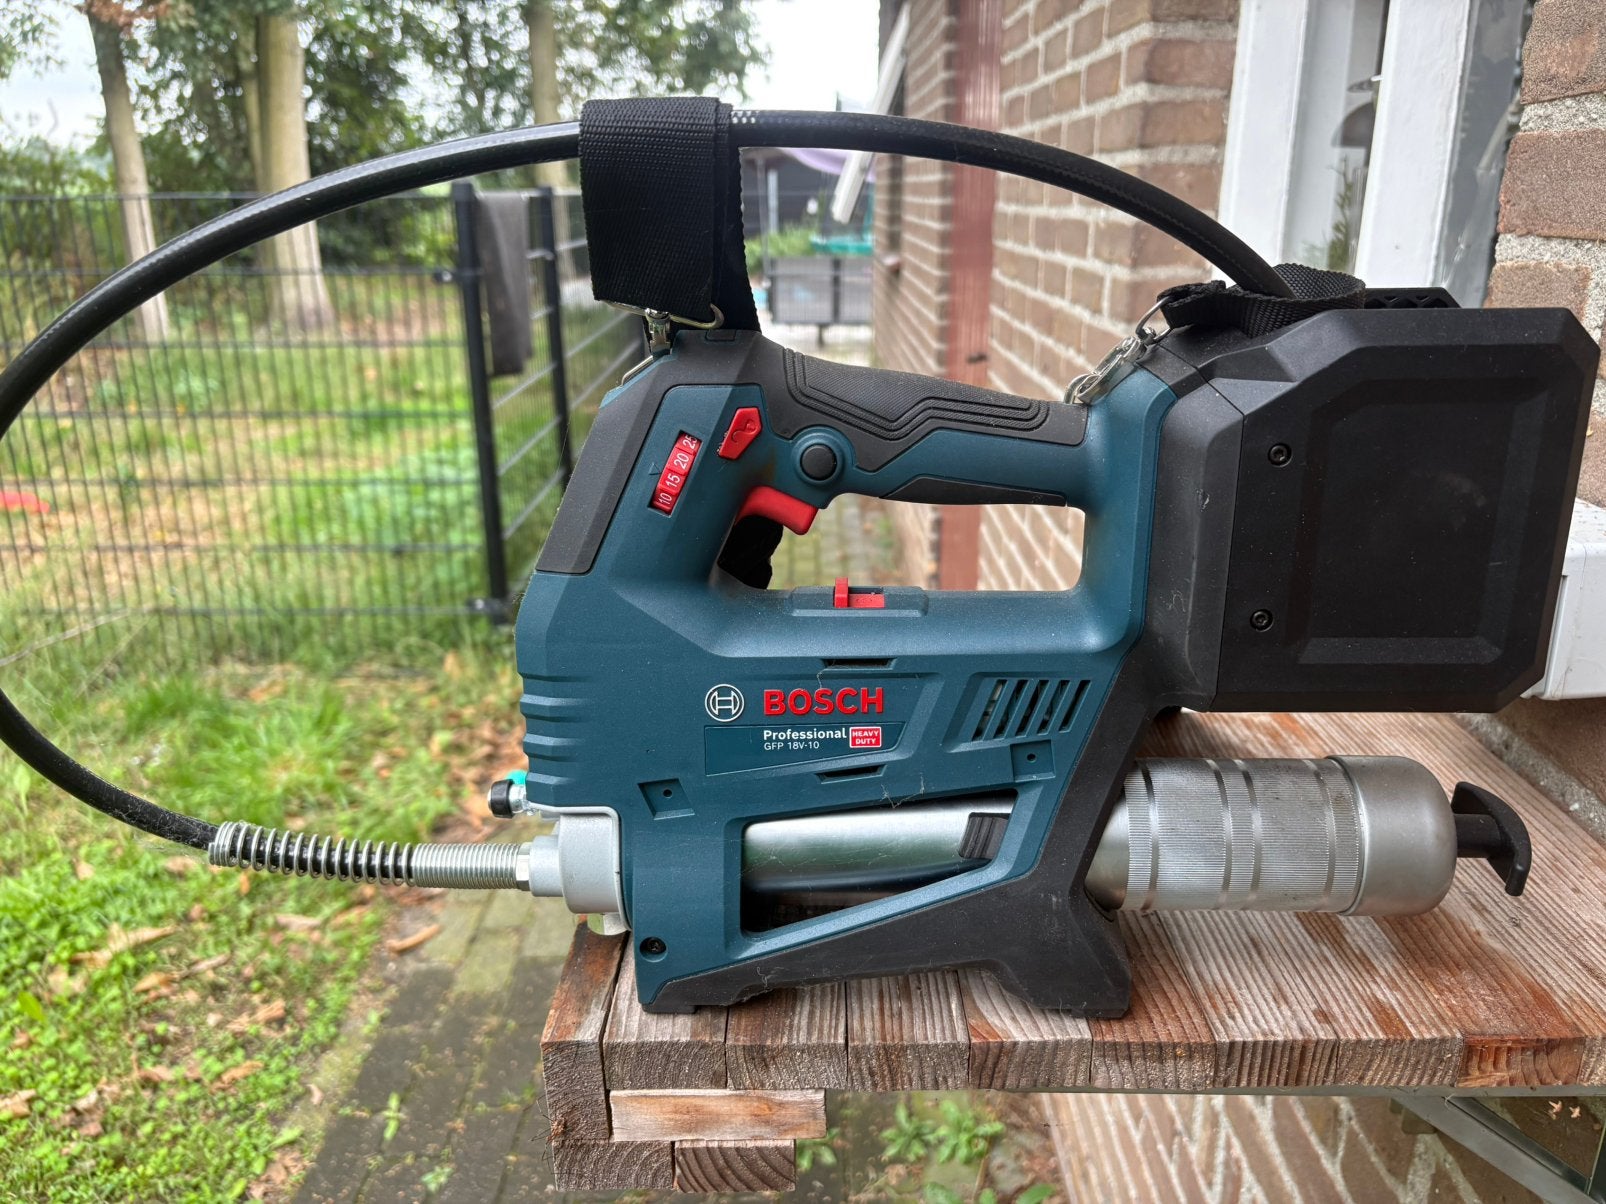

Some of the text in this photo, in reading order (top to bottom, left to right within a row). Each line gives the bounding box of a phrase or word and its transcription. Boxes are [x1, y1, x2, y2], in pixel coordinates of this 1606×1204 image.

[674, 453, 689, 470] 20
[666, 473, 680, 487] 15
[659, 493, 672, 504] 10
[764, 687, 884, 715] BOSCH
[764, 728, 846, 740] Professional
[764, 741, 819, 750] GFP 18V-10
